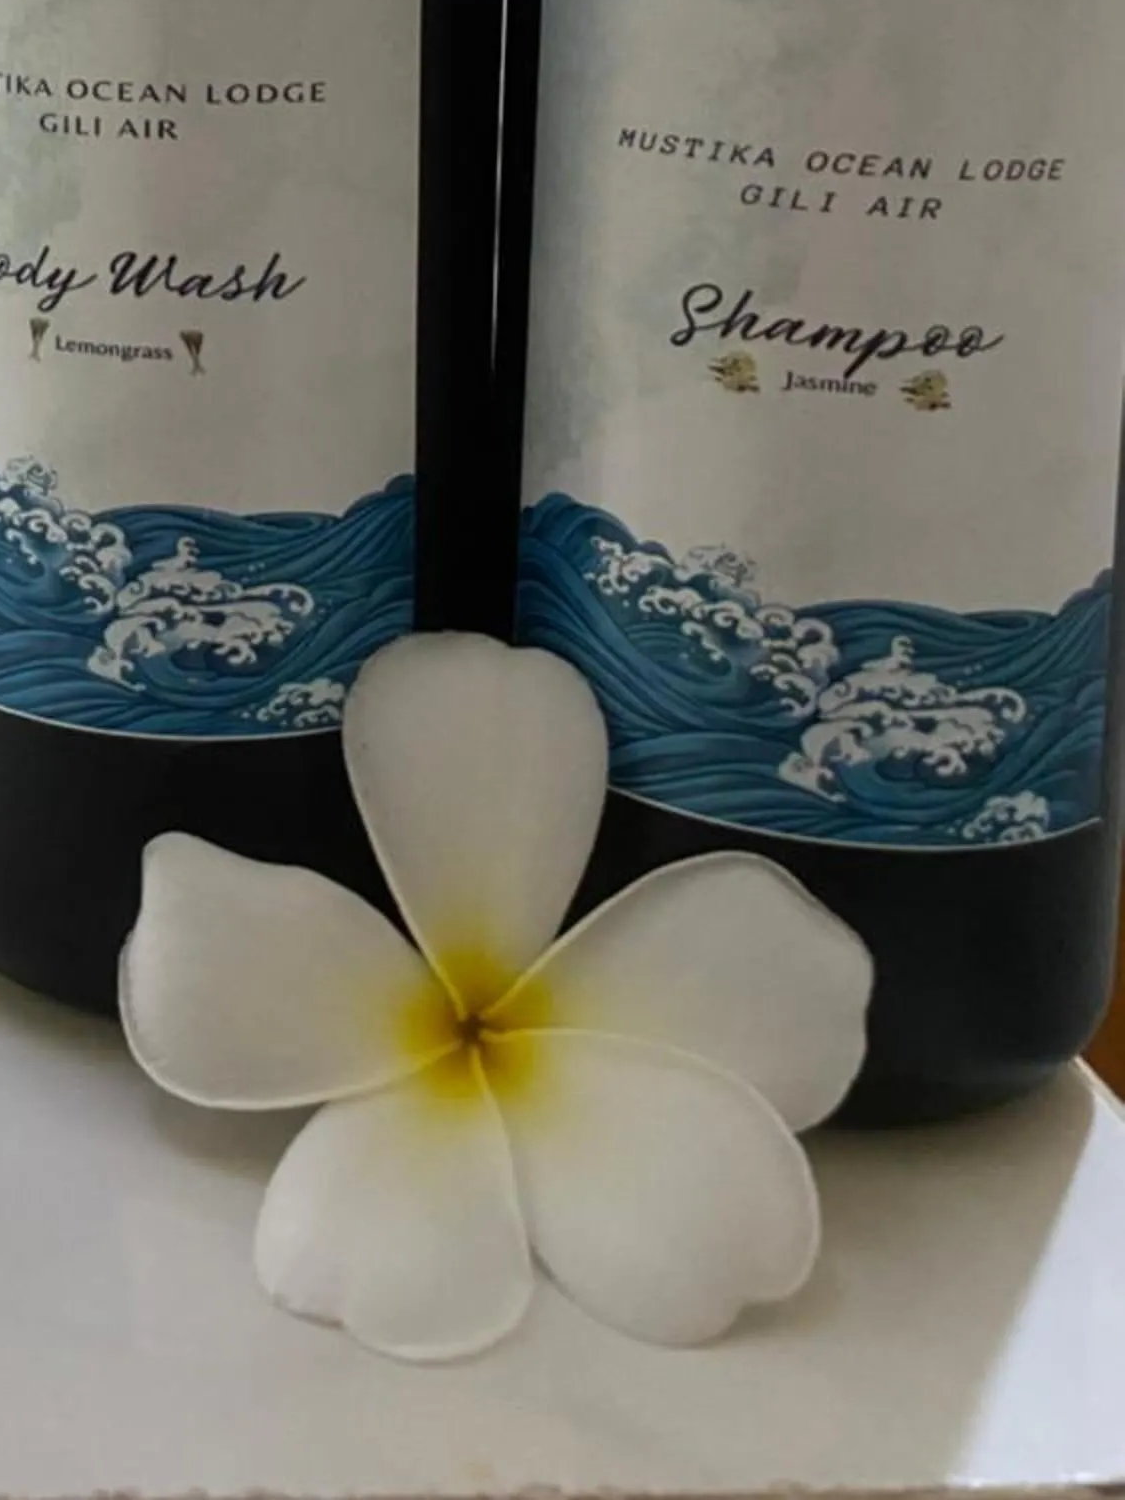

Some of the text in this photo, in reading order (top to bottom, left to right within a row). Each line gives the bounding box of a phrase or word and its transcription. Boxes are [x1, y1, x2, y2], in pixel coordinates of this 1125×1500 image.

[66, 78, 188, 104] OCEAN
[205, 81, 328, 105] LODGE
[39, 112, 179, 140] GILI AIR
[618, 128, 1066, 182] MUSTIKA OCEAN LODGE
[740, 184, 943, 220] GILI AIR
[109, 251, 307, 303] Wash
[670, 283, 1004, 378] Shampoo
[54, 334, 173, 363] Lemongrass
[781, 369, 879, 397] Jasmine
